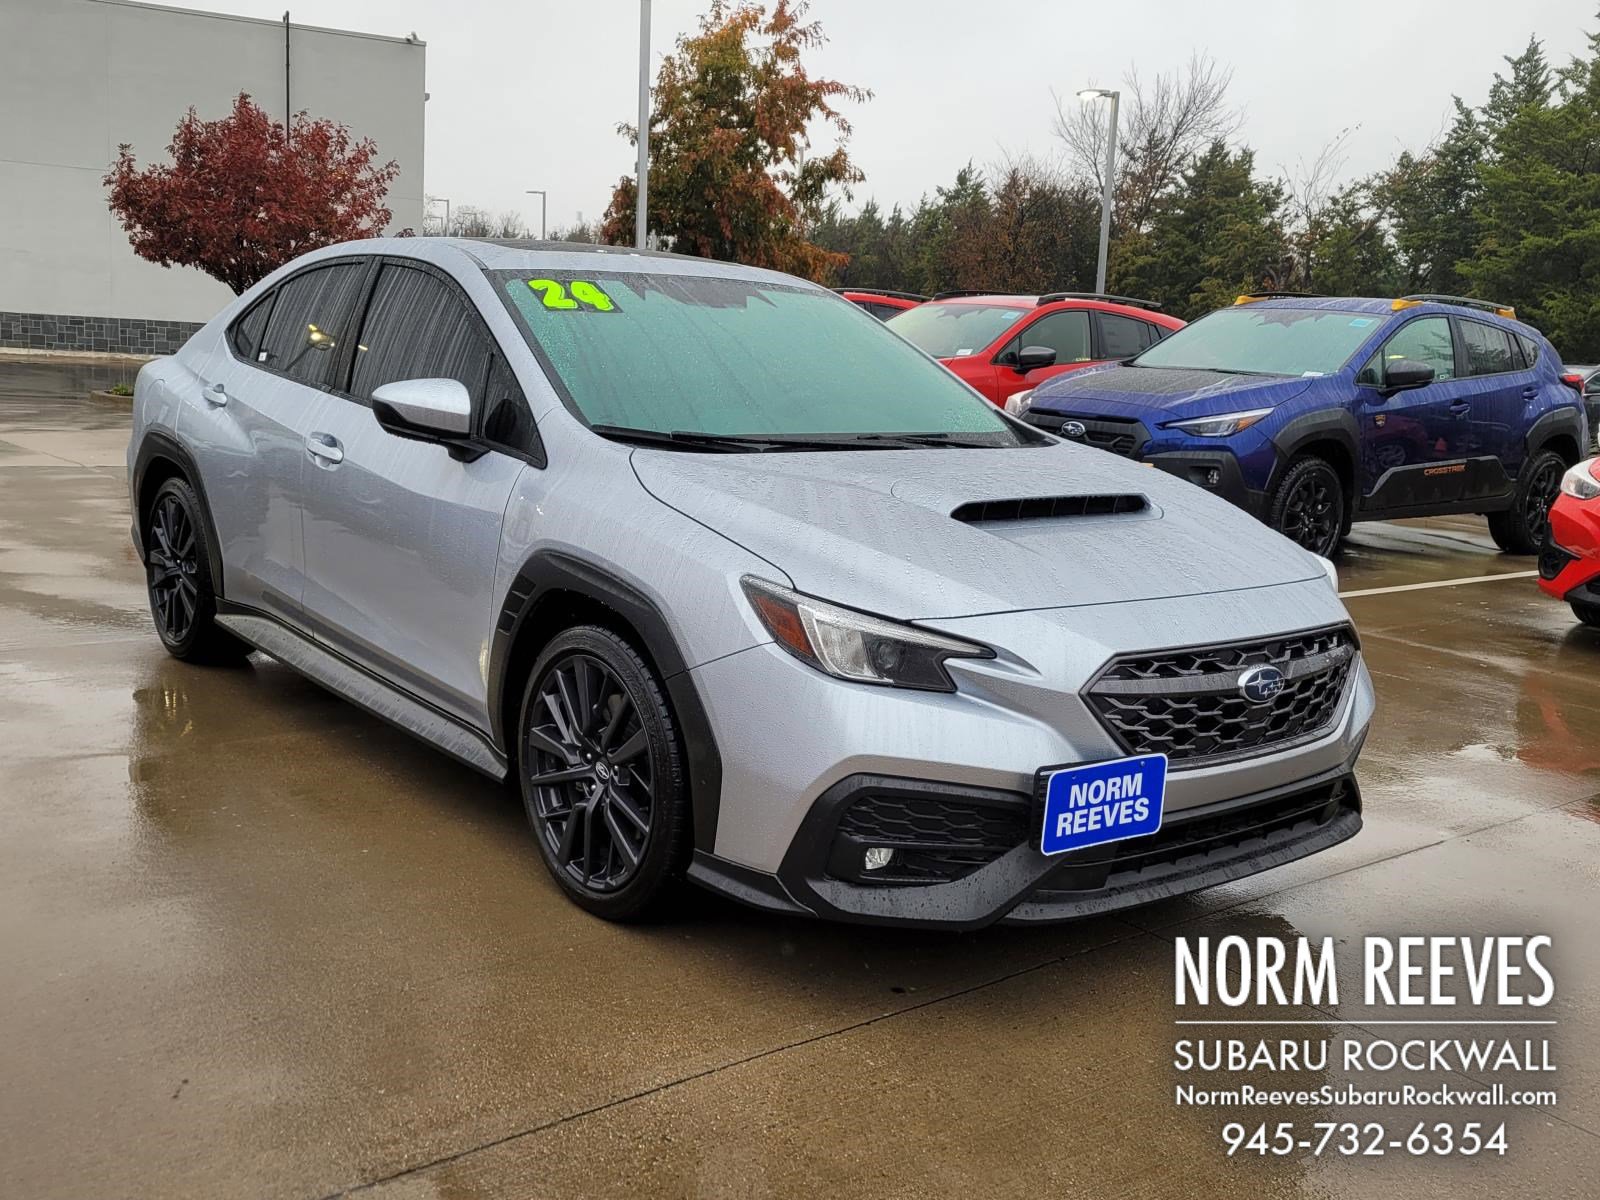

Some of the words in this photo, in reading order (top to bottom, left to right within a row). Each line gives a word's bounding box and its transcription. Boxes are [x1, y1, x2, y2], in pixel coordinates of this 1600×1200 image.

[527, 279, 615, 311] 24
[1424, 465, 1465, 476] CROSSTREK
[1068, 772, 1143, 809] NORM
[1055, 797, 1150, 838] REEVES
